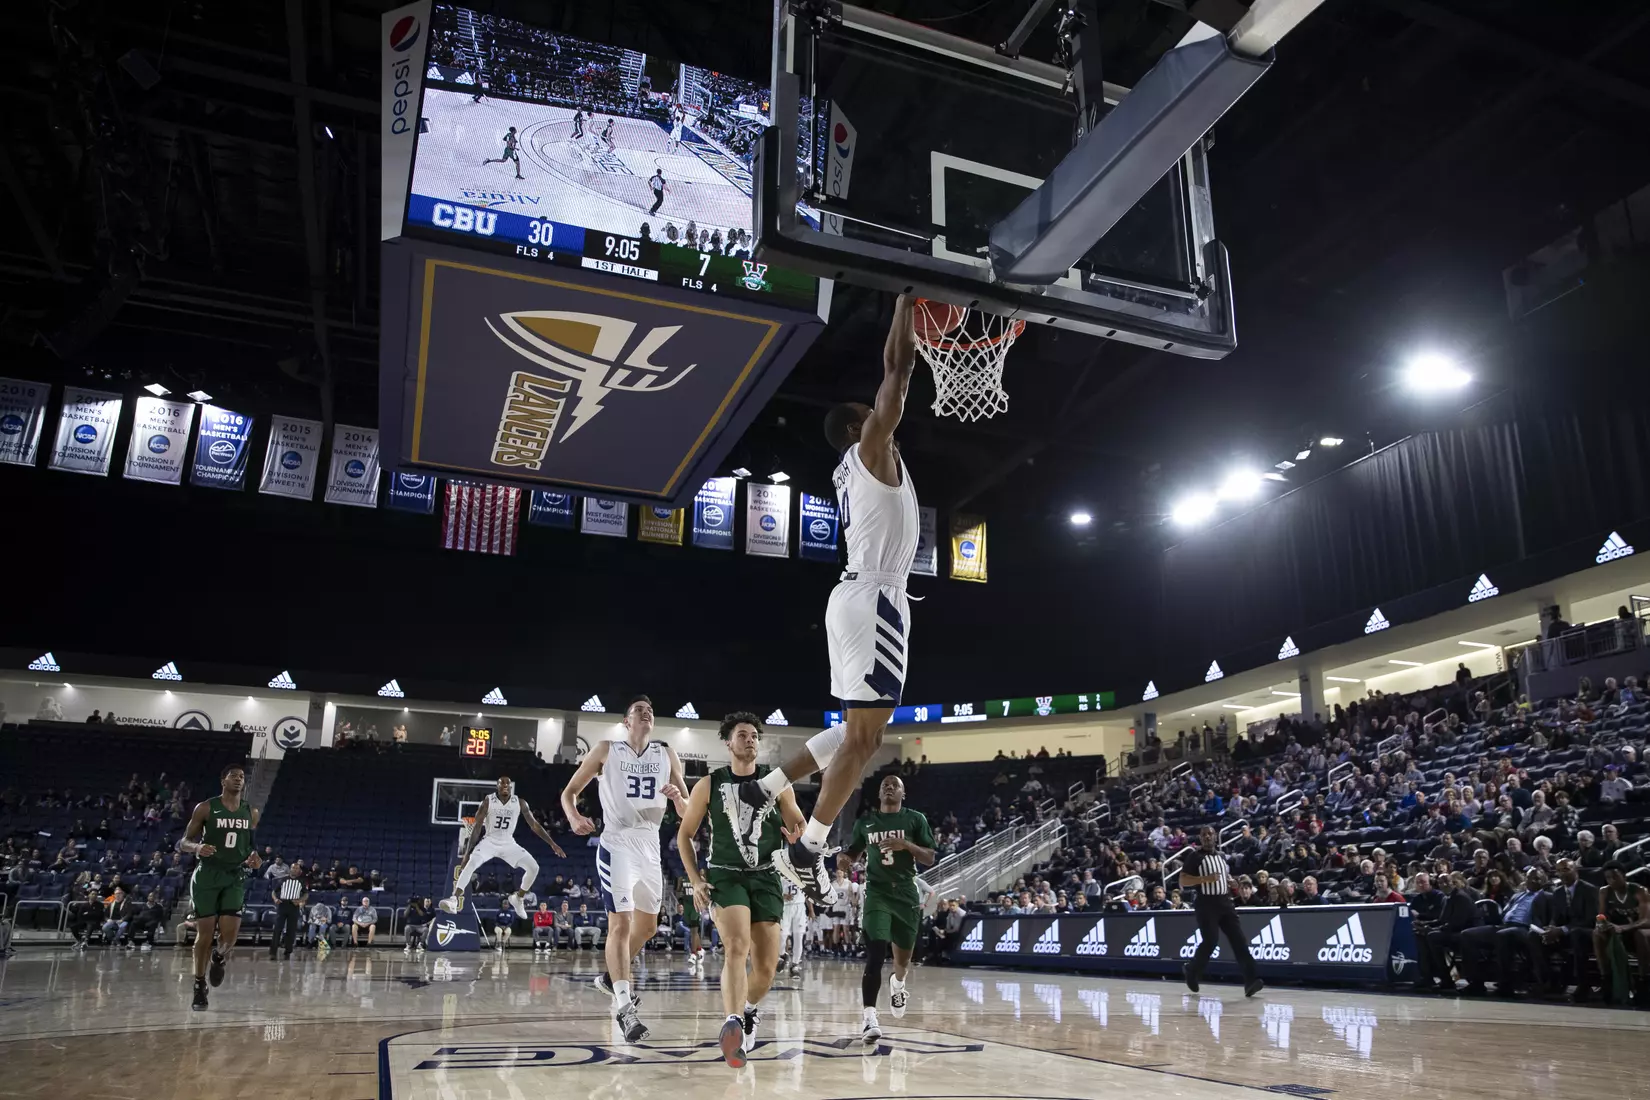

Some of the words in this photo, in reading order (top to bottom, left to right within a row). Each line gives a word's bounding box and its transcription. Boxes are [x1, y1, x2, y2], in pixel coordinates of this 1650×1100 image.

[391, 58, 413, 134] pepsi
[432, 202, 498, 236] CBU
[528, 220, 554, 246] 30
[516, 245, 539, 258] FLS
[547, 251, 554, 260] 4
[605, 236, 641, 261] 9:05
[595, 260, 615, 271] 1ST
[621, 265, 650, 278] HALF
[699, 254, 711, 277] 7
[682, 277, 703, 289] FLS
[711, 283, 717, 292] 4
[76, 394, 107, 407] 2017
[76, 407, 102, 415] MEN'S
[149, 406, 180, 417] 2016
[62, 411, 113, 425] BASKETBAL
[150, 417, 175, 425] MEN'S
[491, 371, 572, 470] LANCERS
[136, 423, 186, 435] BASKETBALL
[213, 424, 238, 433] MEN'S
[282, 423, 311, 435] 2015
[344, 432, 372, 443] 2014
[62, 446, 96, 455] DIVISION
[345, 443, 368, 451] MEN'S
[55, 451, 107, 463] TOURNAMENT
[137, 455, 170, 464] DIVISION
[130, 460, 180, 473] TOURNAMENT
[268, 470, 302, 480] DIVISION
[269, 479, 295, 487] SWEET
[336, 480, 365, 488] DIVISION
[389, 489, 432, 500] CHAMPIONS
[532, 505, 574, 515] CHAMPIONS
[805, 503, 834, 513] WOMEN'S
[586, 518, 623, 526] CHAMPIONS
[644, 526, 677, 534] NATIONAL
[693, 527, 732, 537] CHAMPIONS
[749, 538, 787, 547] TOURNAMENT
[802, 541, 837, 550] CHAMPIONS
[1596, 545, 1634, 564] adidas
[1468, 585, 1499, 603] adidas
[1364, 620, 1390, 634] adidas
[1278, 648, 1299, 660] adidas
[28, 663, 60, 672] adidas
[152, 672, 182, 681] adidas
[268, 680, 296, 689] adidas
[377, 689, 405, 698] adidas
[481, 697, 508, 706] adidas
[580, 704, 606, 713] adidas
[953, 702, 973, 716] 9:05
[1002, 701, 1010, 717] 7
[675, 711, 699, 720] adidas
[914, 707, 928, 723] 30
[766, 717, 789, 726] adidas
[470, 729, 490, 740] 9:05
[466, 739, 486, 755] 28
[620, 761, 660, 773] LANCERS
[626, 775, 656, 800] 33
[216, 818, 249, 829] MVSU
[494, 815, 511, 830] 35
[225, 831, 237, 848] 0
[881, 849, 895, 866] 3
[685, 887, 694, 895] 10
[788, 885, 798, 896] 15
[961, 940, 984, 950] adidas
[995, 940, 1020, 952] adidas
[1033, 940, 1061, 953] adidas
[1076, 941, 1108, 955] adidas
[1124, 942, 1159, 957] adidas
[1318, 944, 1373, 962] adidas
